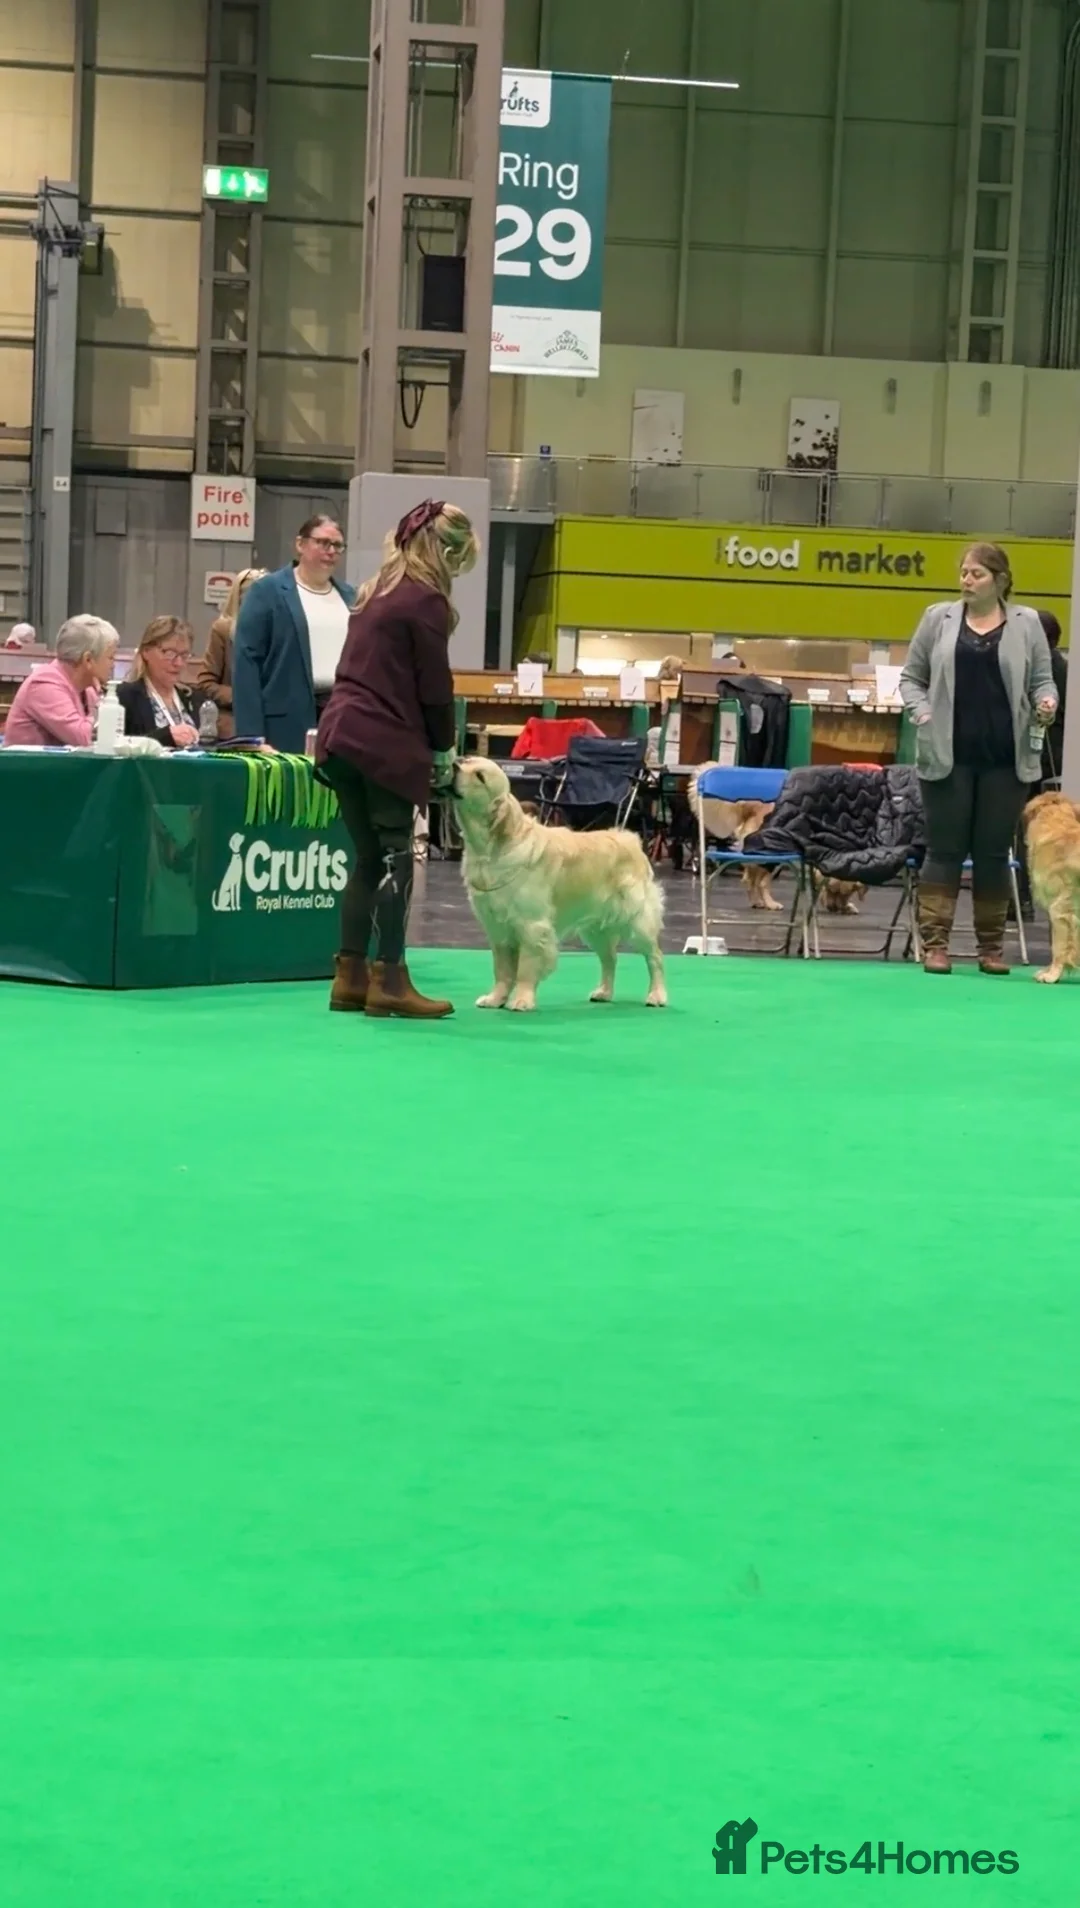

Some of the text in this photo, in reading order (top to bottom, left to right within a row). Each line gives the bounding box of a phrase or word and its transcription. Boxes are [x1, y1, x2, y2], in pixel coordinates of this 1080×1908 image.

[500, 97, 540, 112] rufts
[498, 152, 579, 200] Ring
[493, 204, 592, 281] 29
[204, 486, 243, 504] Fire
[197, 509, 250, 528] point
[725, 536, 800, 569] food
[817, 543, 925, 577] market
[245, 840, 348, 893] Crufts
[256, 893, 335, 914] Royal Kennel Club
